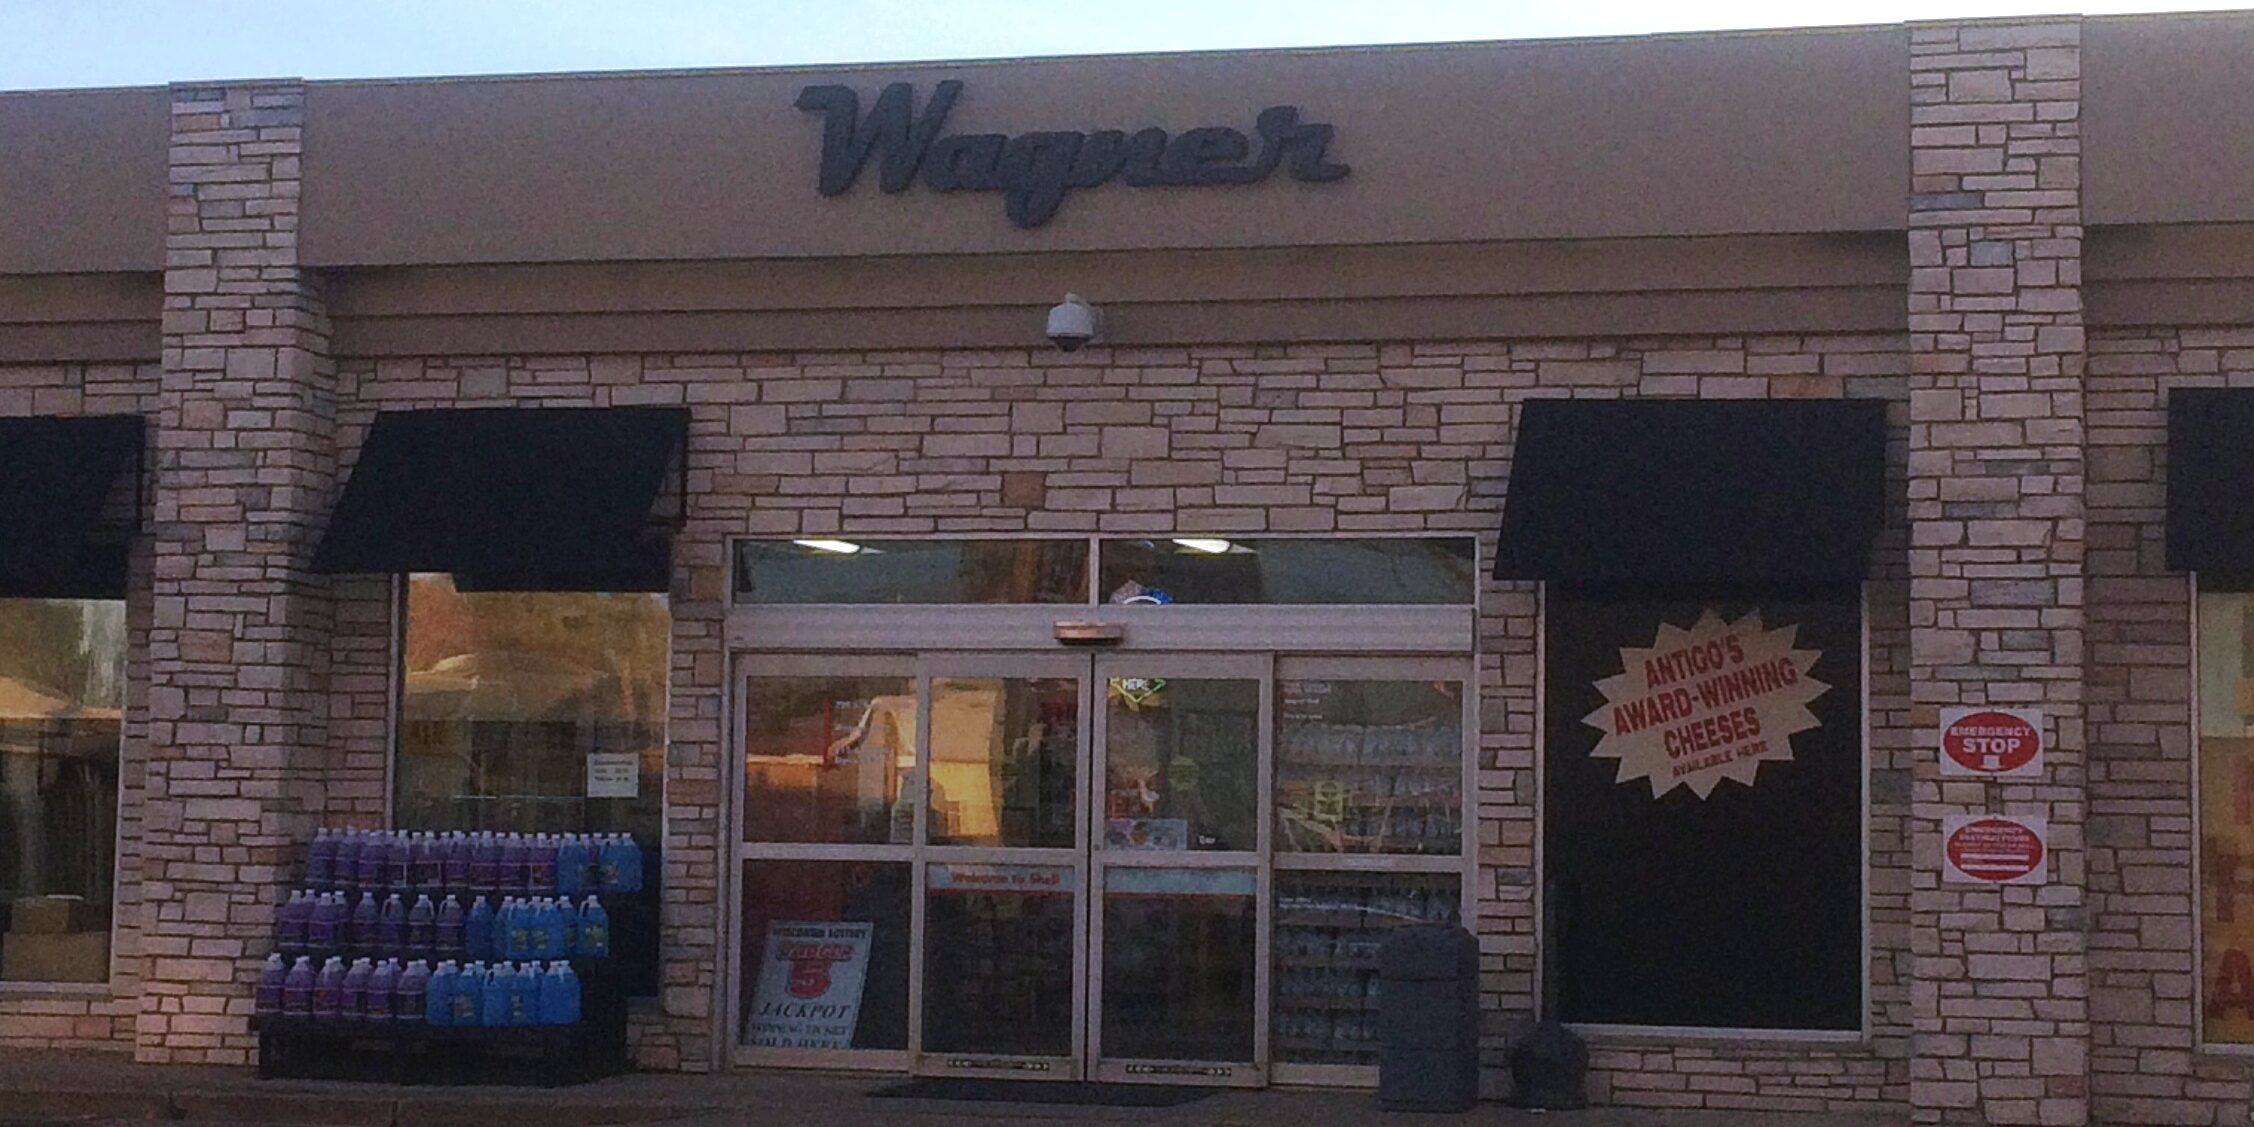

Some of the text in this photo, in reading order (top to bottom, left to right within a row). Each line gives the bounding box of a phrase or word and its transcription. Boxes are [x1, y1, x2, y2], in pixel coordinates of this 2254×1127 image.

[792, 79, 1351, 228] Wagner
[1644, 635, 1744, 688] ANTIGO'S
[1613, 657, 1799, 736] AWARD-WINNING
[1663, 707, 1761, 759] CHEESES
[1736, 740, 1768, 758] HERE
[1950, 726, 2032, 737] EMERGENCY
[1963, 739, 2021, 753] STOP
[759, 1002, 850, 1018] JACKPOT
